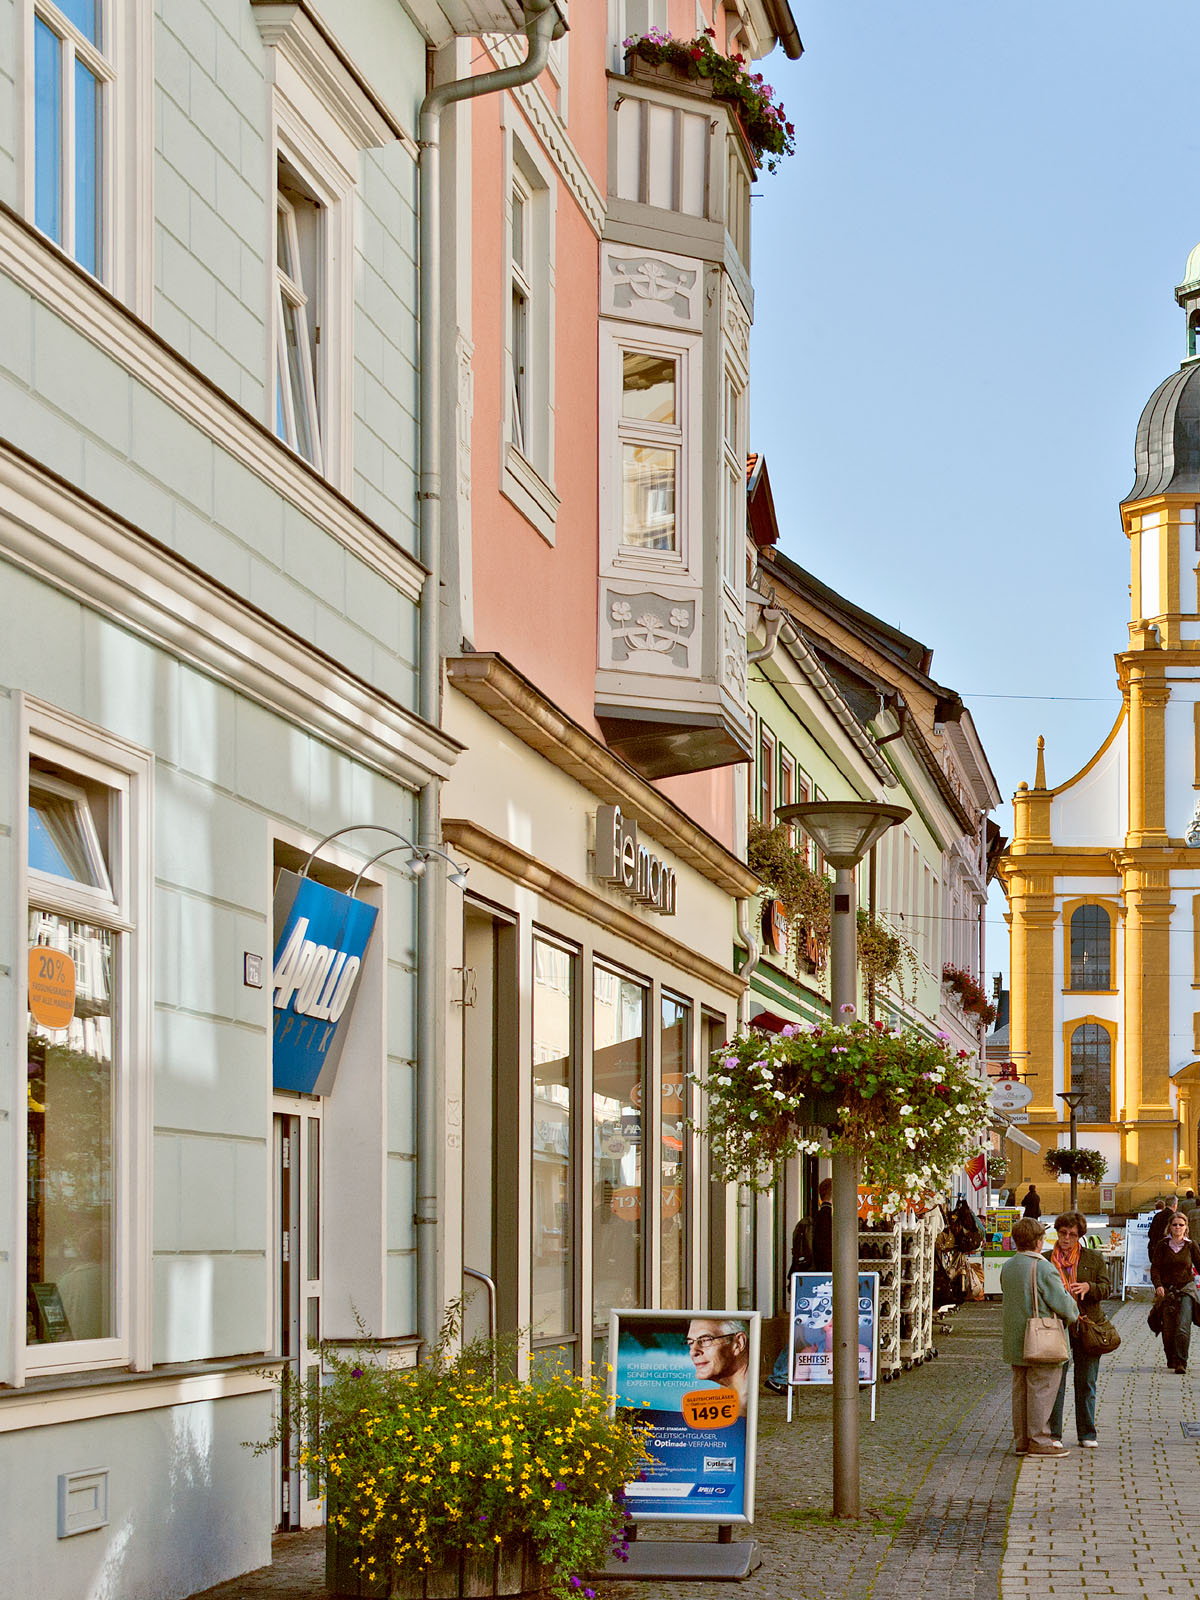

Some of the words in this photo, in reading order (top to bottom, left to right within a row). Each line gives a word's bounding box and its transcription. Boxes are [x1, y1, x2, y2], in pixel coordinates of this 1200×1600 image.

[38, 955, 54, 980] 20
[273, 917, 360, 1023] APOLLO
[798, 1355, 830, 1364] SEHTEST:
[626, 1380, 661, 1388] EXPERTEN
[691, 1406, 719, 1421] 149
